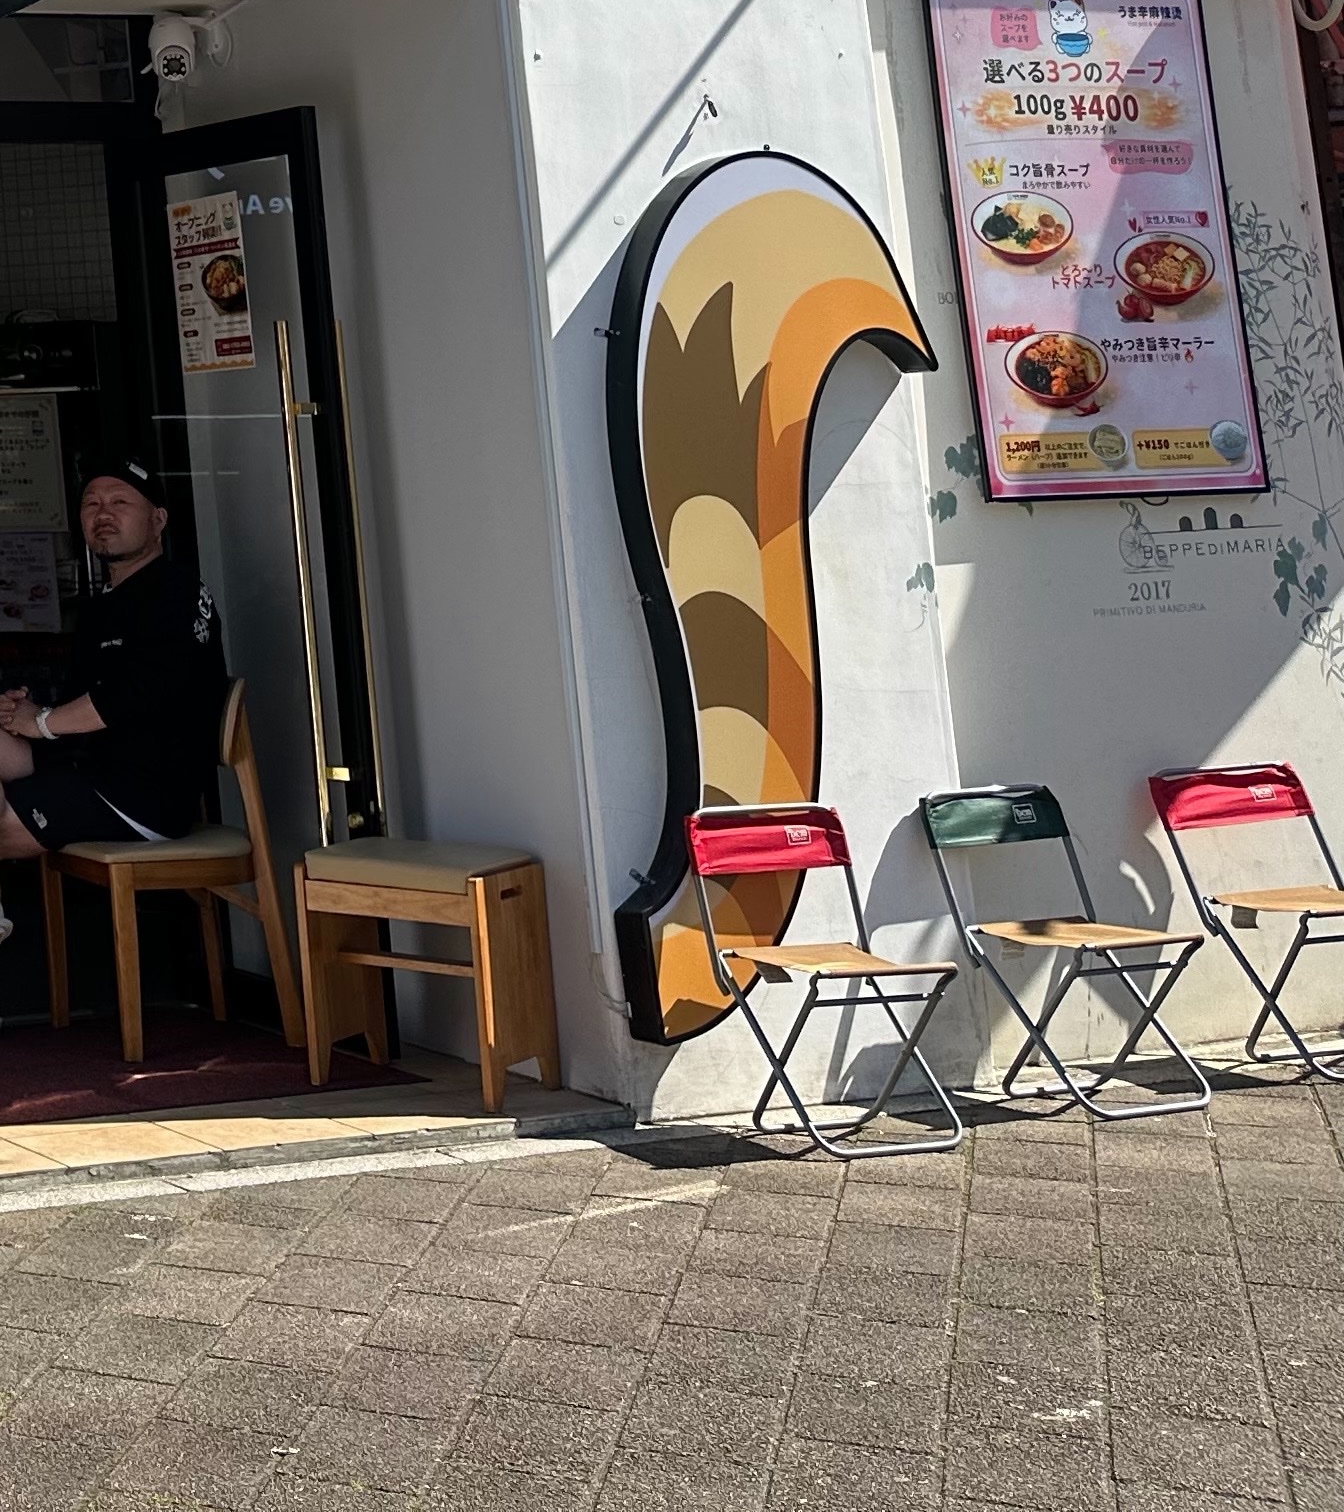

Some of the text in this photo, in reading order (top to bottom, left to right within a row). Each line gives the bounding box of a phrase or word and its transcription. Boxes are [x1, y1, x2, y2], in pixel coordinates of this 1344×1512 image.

[983, 59, 1168, 84] 選べる3つのスープ
[1013, 94, 1139, 122] 100g ¥400
[1046, 124, 1117, 135] 量り売りスタイル
[1052, 276, 1116, 289] トマトスープ
[1100, 336, 1215, 352] やみつき旨辛マーラー
[1128, 579, 1172, 602] 2017
[1145, 605, 1157, 615] DI
